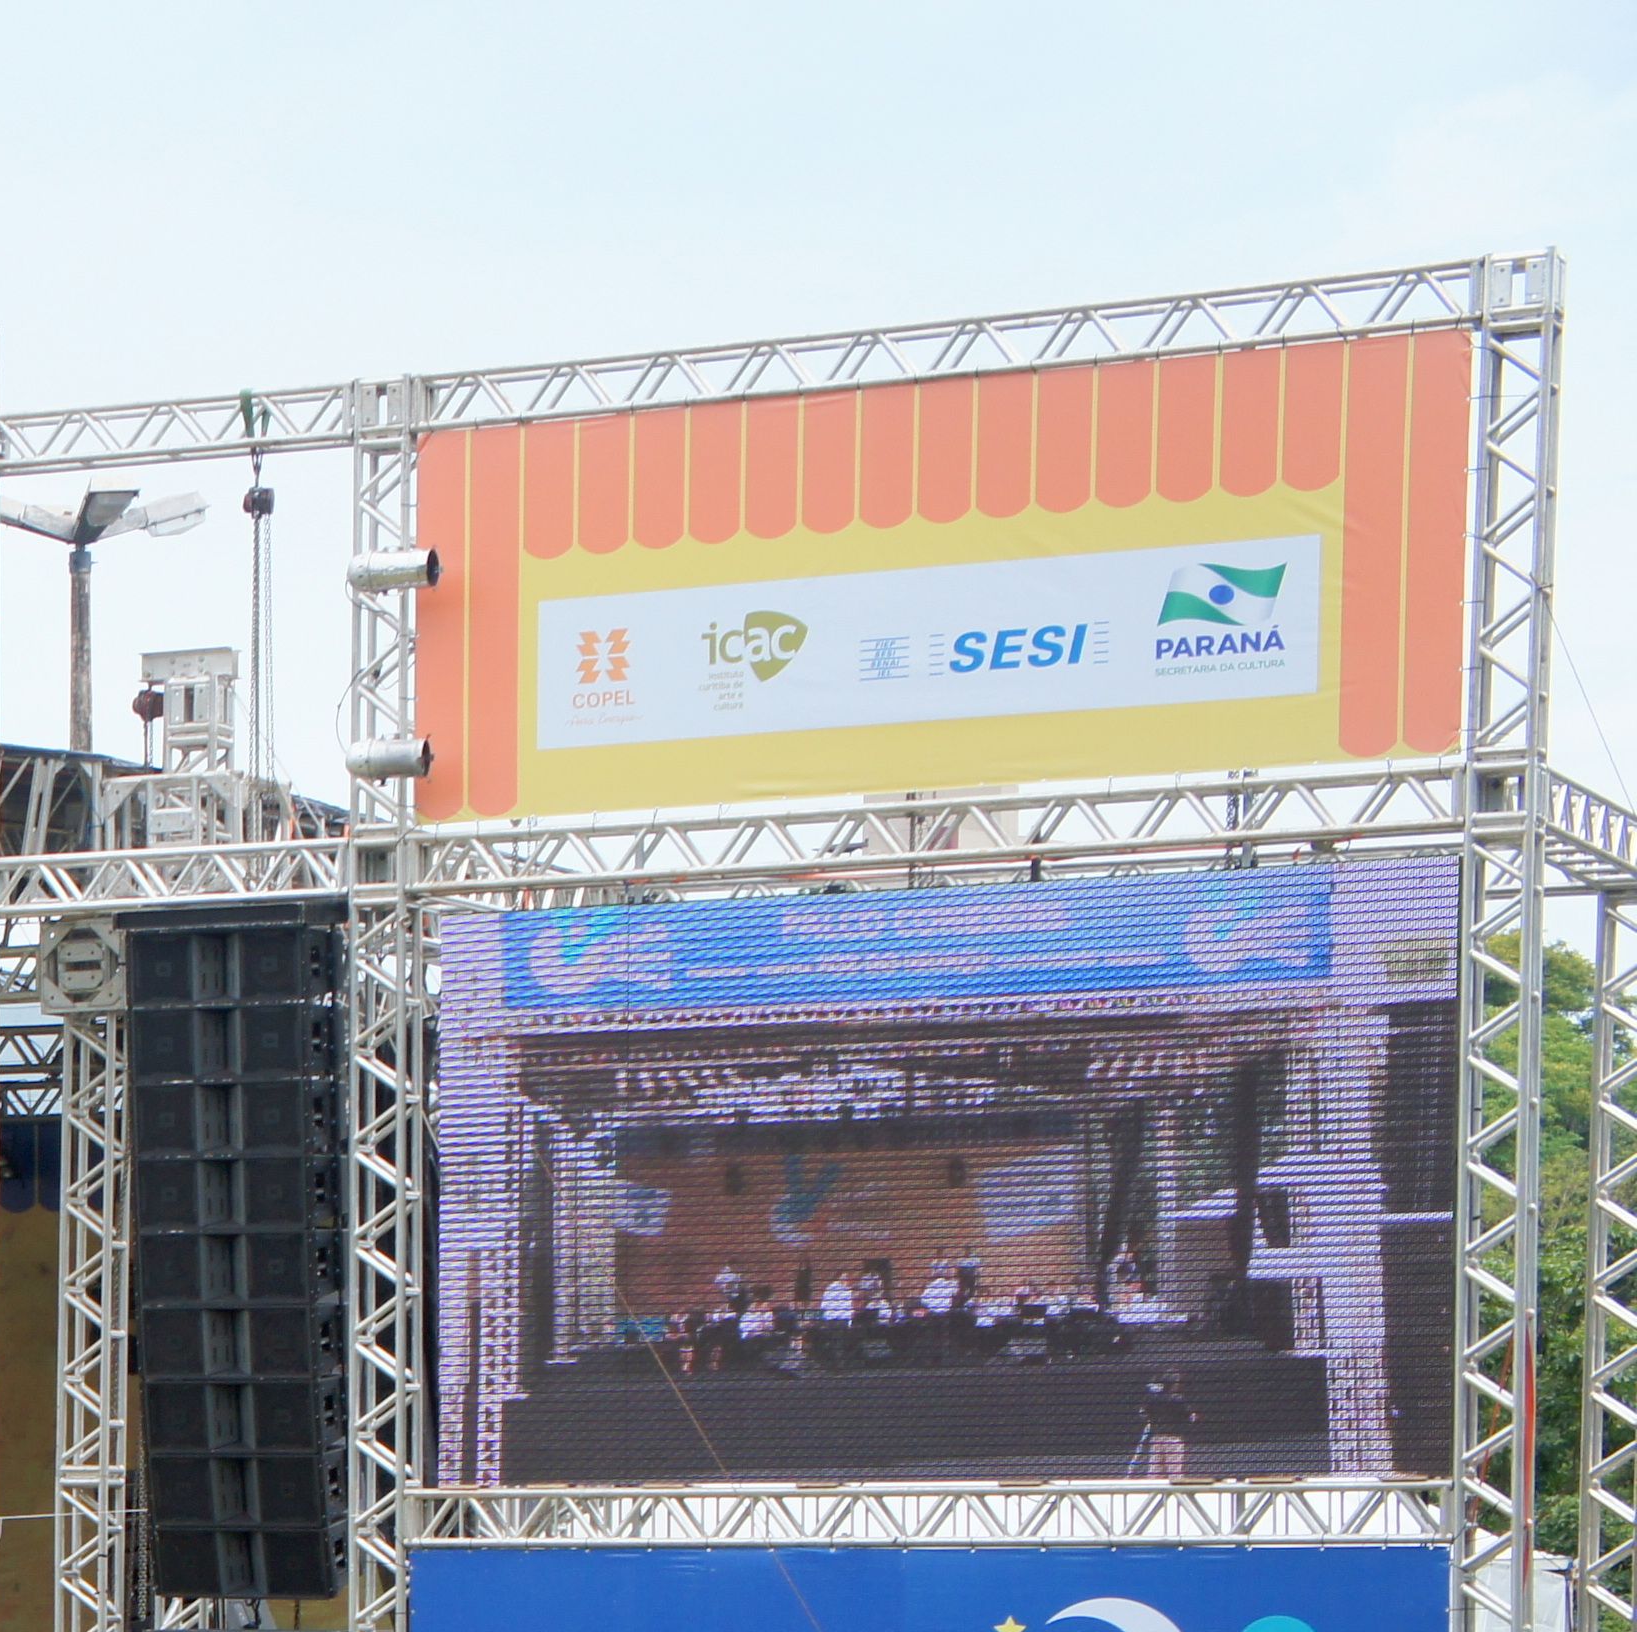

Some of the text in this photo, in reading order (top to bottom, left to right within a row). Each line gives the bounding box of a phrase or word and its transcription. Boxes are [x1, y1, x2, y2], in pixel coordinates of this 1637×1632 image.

[701, 620, 798, 665] icac
[950, 623, 1089, 673] SESI
[1155, 624, 1285, 660] PARANÁ
[1155, 659, 1286, 677] SECRETARIA DA CULTURA
[572, 690, 636, 709] COPEL
